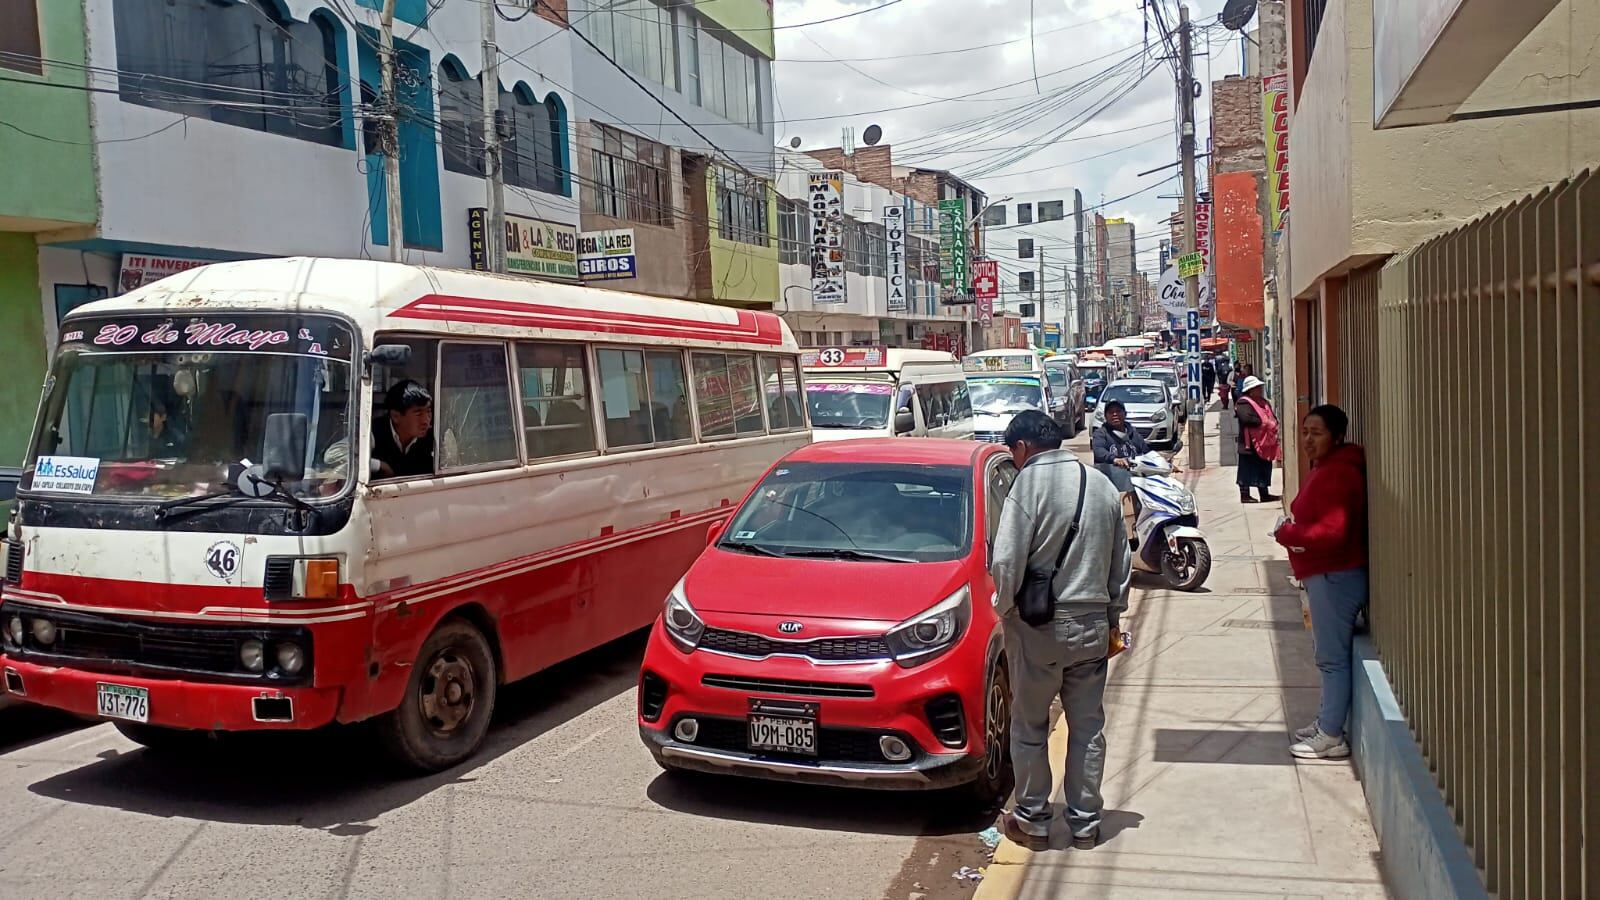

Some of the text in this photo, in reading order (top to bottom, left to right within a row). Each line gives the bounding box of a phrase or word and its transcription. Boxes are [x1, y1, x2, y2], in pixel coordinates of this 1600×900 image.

[472, 210, 483, 270] AGENTE
[530, 226, 543, 247] LA
[557, 231, 575, 252] RED
[577, 235, 631, 254] MEGA LA RED
[579, 257, 630, 274] GIROS
[889, 226, 903, 298] ÓPTICA
[973, 263, 996, 280] BOTICA
[94, 324, 138, 345] 20
[141, 324, 179, 344] de
[184, 322, 289, 350] Mayo
[308, 342, 328, 355] A.
[823, 350, 842, 364] 33
[55, 465, 97, 480] EsSalud
[208, 549, 236, 572] 46
[781, 623, 798, 631] KIA
[99, 692, 146, 717] V3T-776
[752, 723, 813, 748] V9M-085
